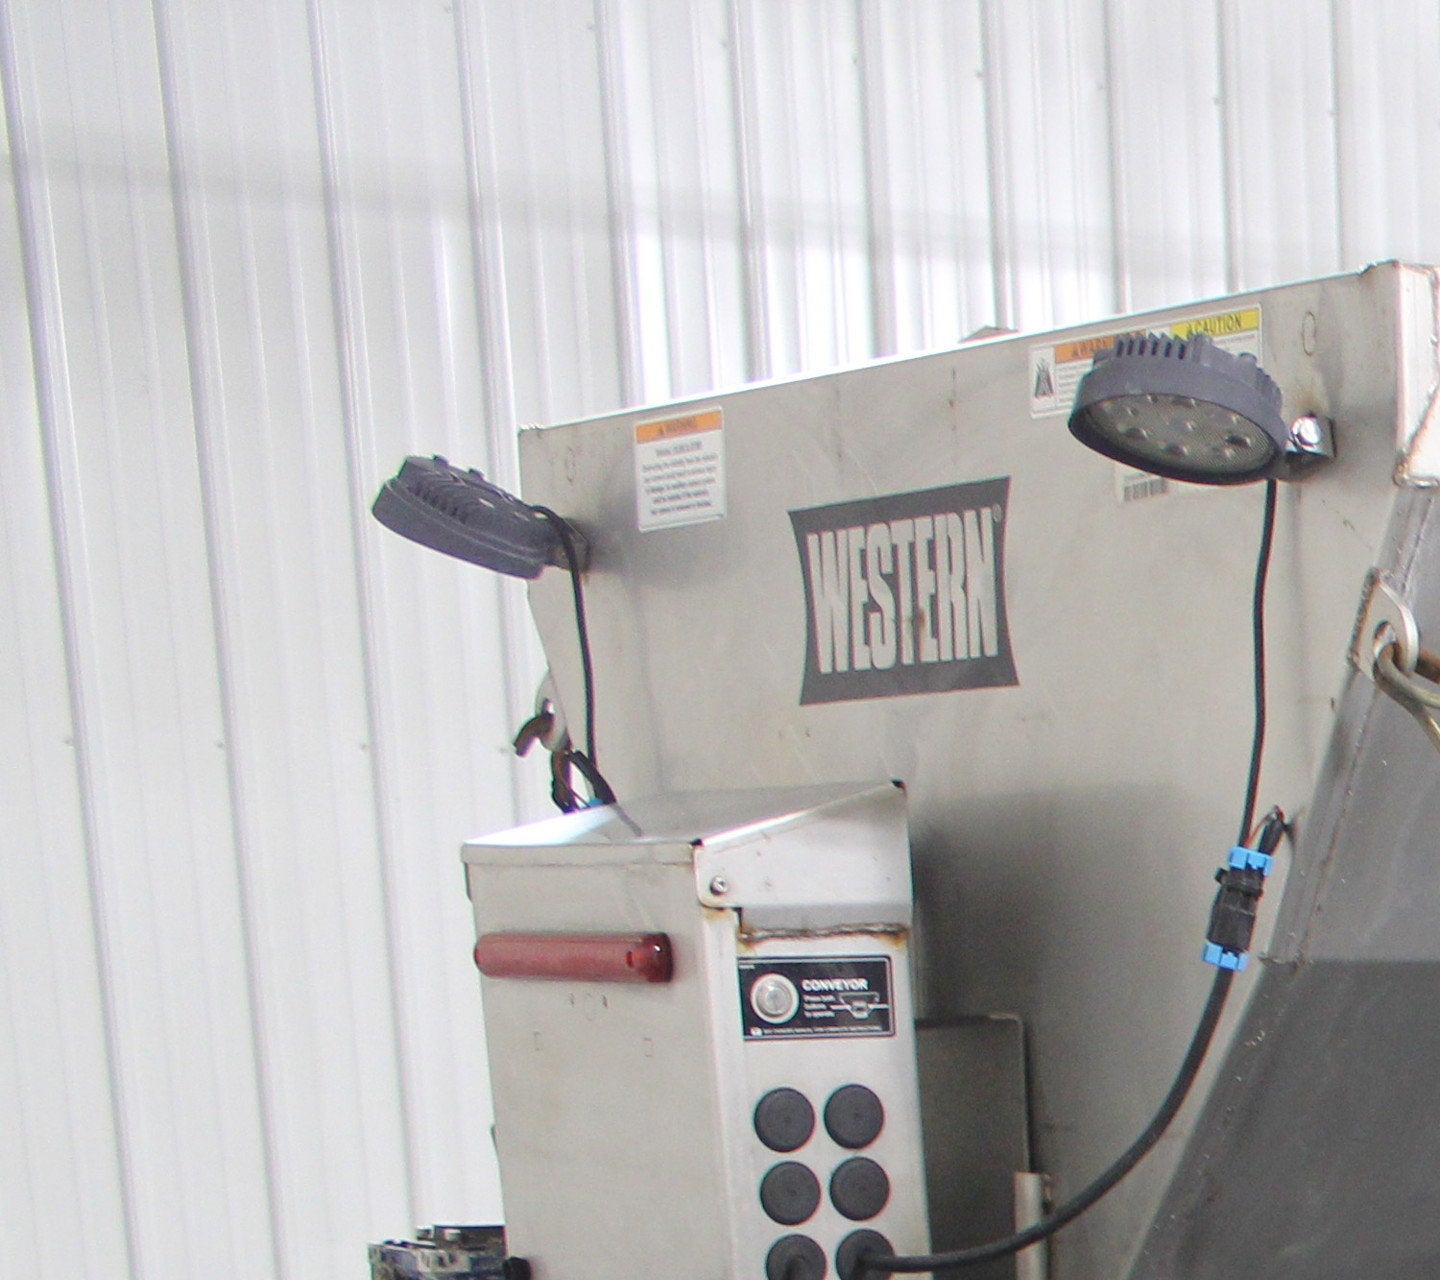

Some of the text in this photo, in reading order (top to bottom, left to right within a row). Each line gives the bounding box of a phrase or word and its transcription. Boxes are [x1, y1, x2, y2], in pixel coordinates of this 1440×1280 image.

[1199, 314, 1242, 336] CAUTION
[806, 506, 999, 675] WESTERN
[801, 978, 869, 991] CONVEYOR
